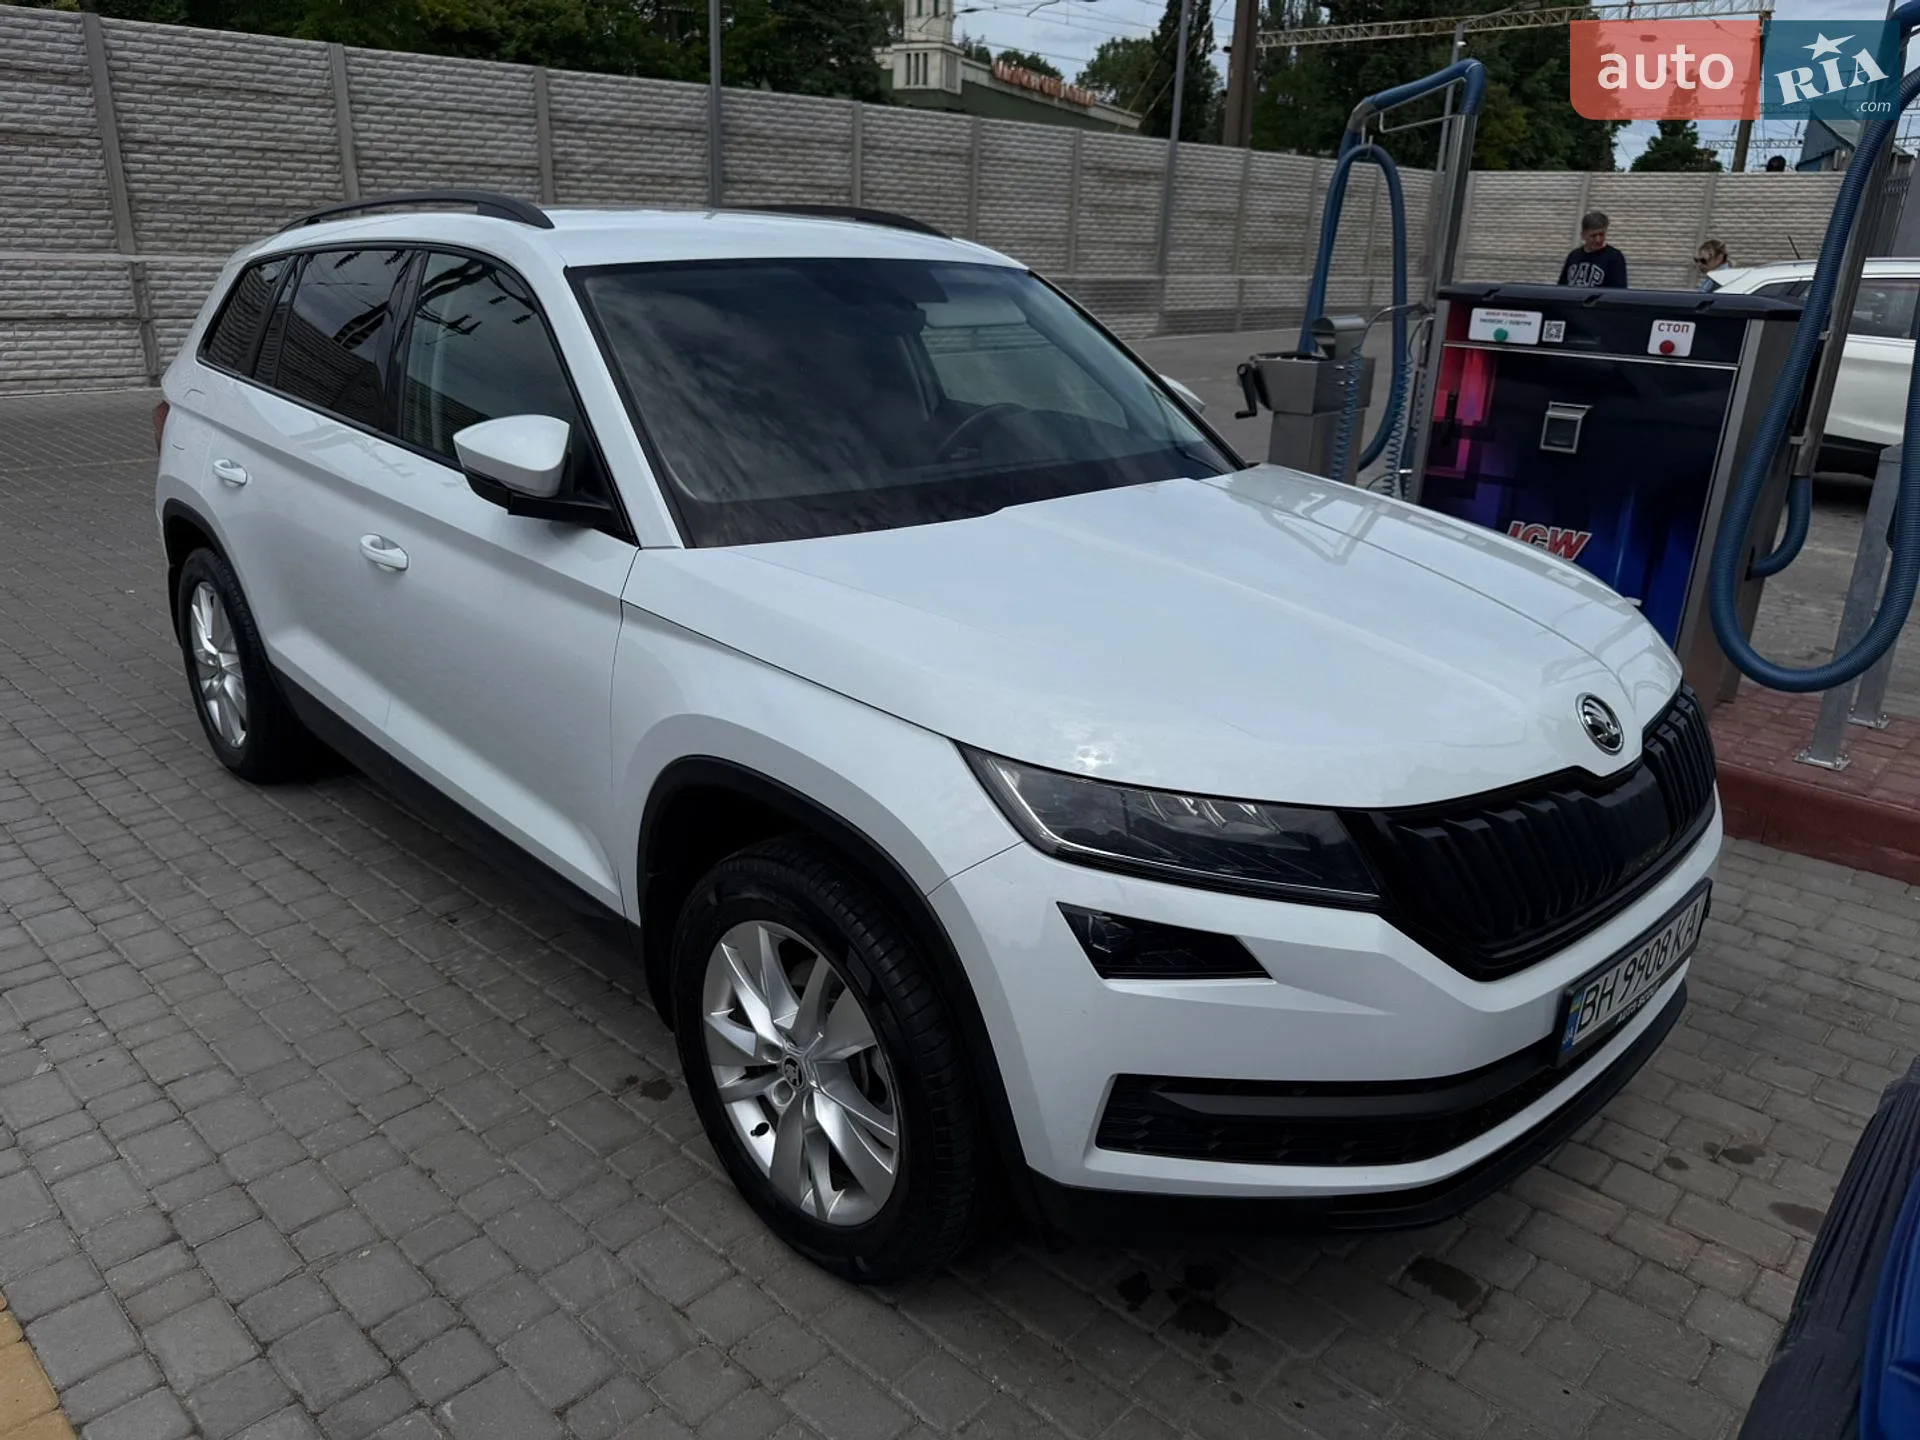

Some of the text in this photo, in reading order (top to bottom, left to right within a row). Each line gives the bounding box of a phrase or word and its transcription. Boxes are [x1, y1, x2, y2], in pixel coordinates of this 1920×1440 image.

[1657, 322, 1690, 333] СТОП
[1576, 967, 1621, 1034] BH
[1619, 928, 1672, 1002] 9908
[1670, 902, 1699, 958] KA
